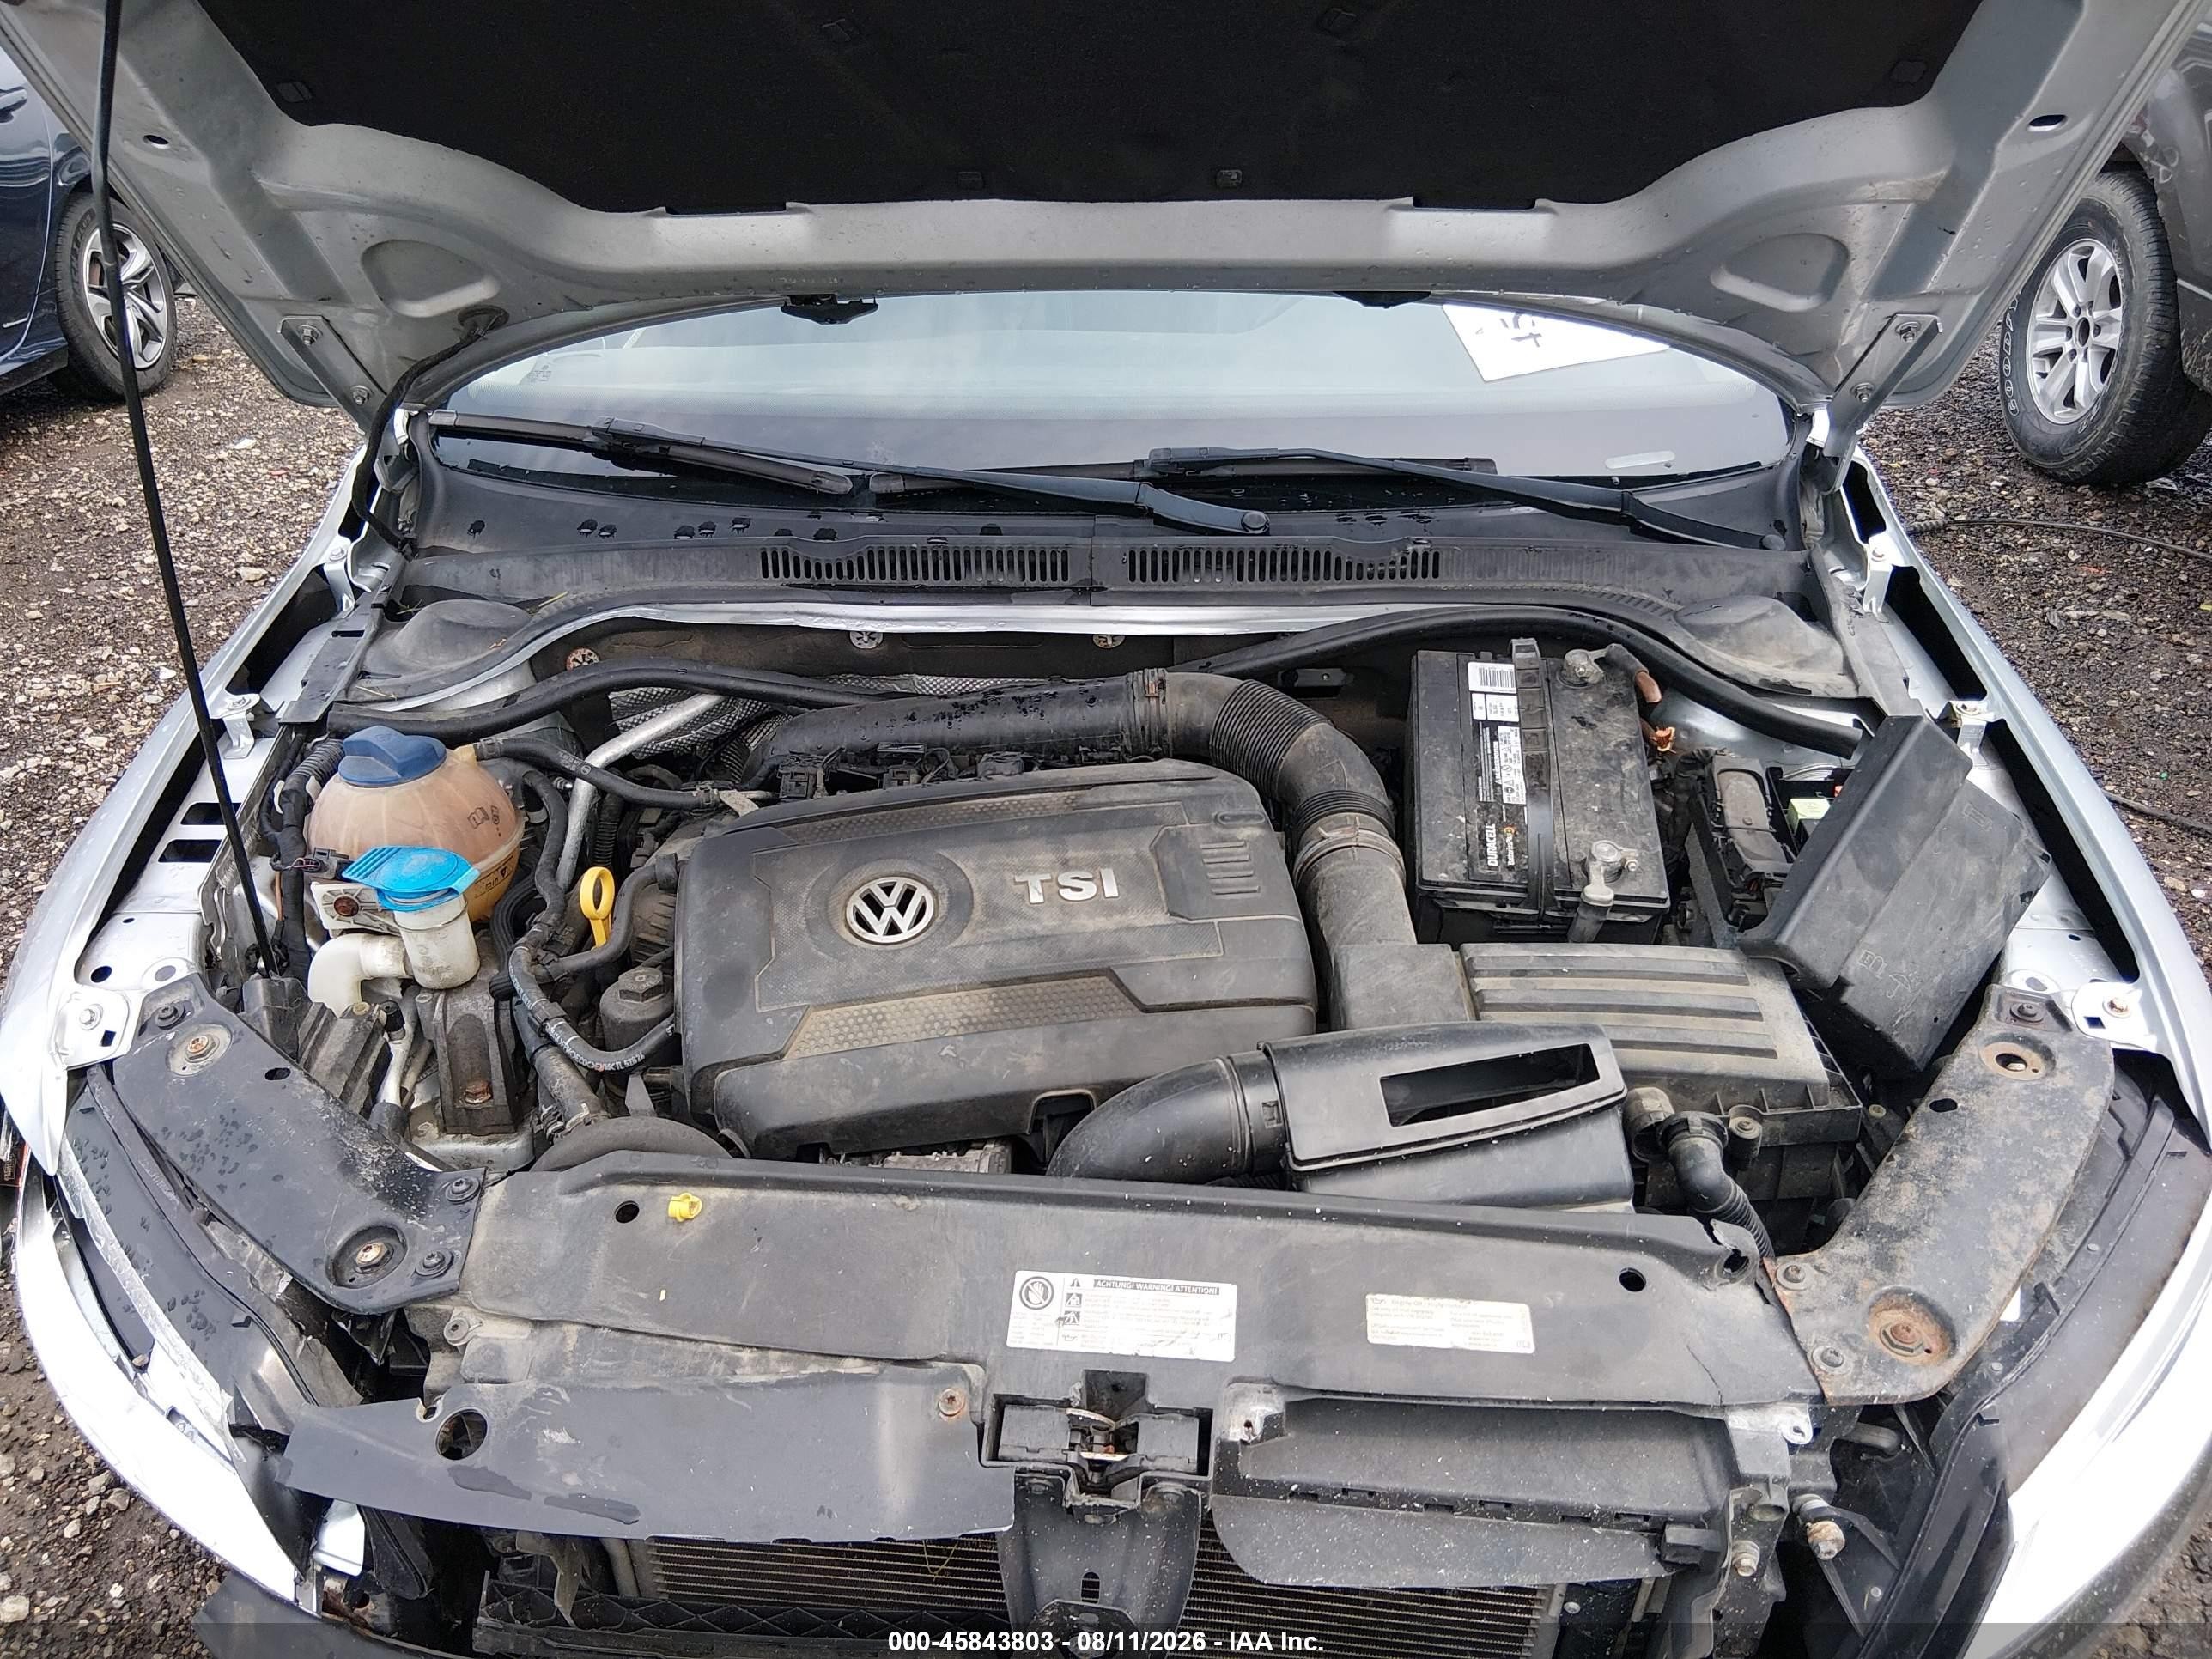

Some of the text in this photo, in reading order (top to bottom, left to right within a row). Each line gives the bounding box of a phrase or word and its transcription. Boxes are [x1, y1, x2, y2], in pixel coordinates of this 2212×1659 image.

[1485, 823, 1498, 866] DURACELL
[485, 877, 499, 890] min
[1014, 867, 1120, 904] TSI
[846, 876, 935, 945] VW
[1097, 1279, 1218, 1296] ACHTUNG! WARNING! ATTENTION!
